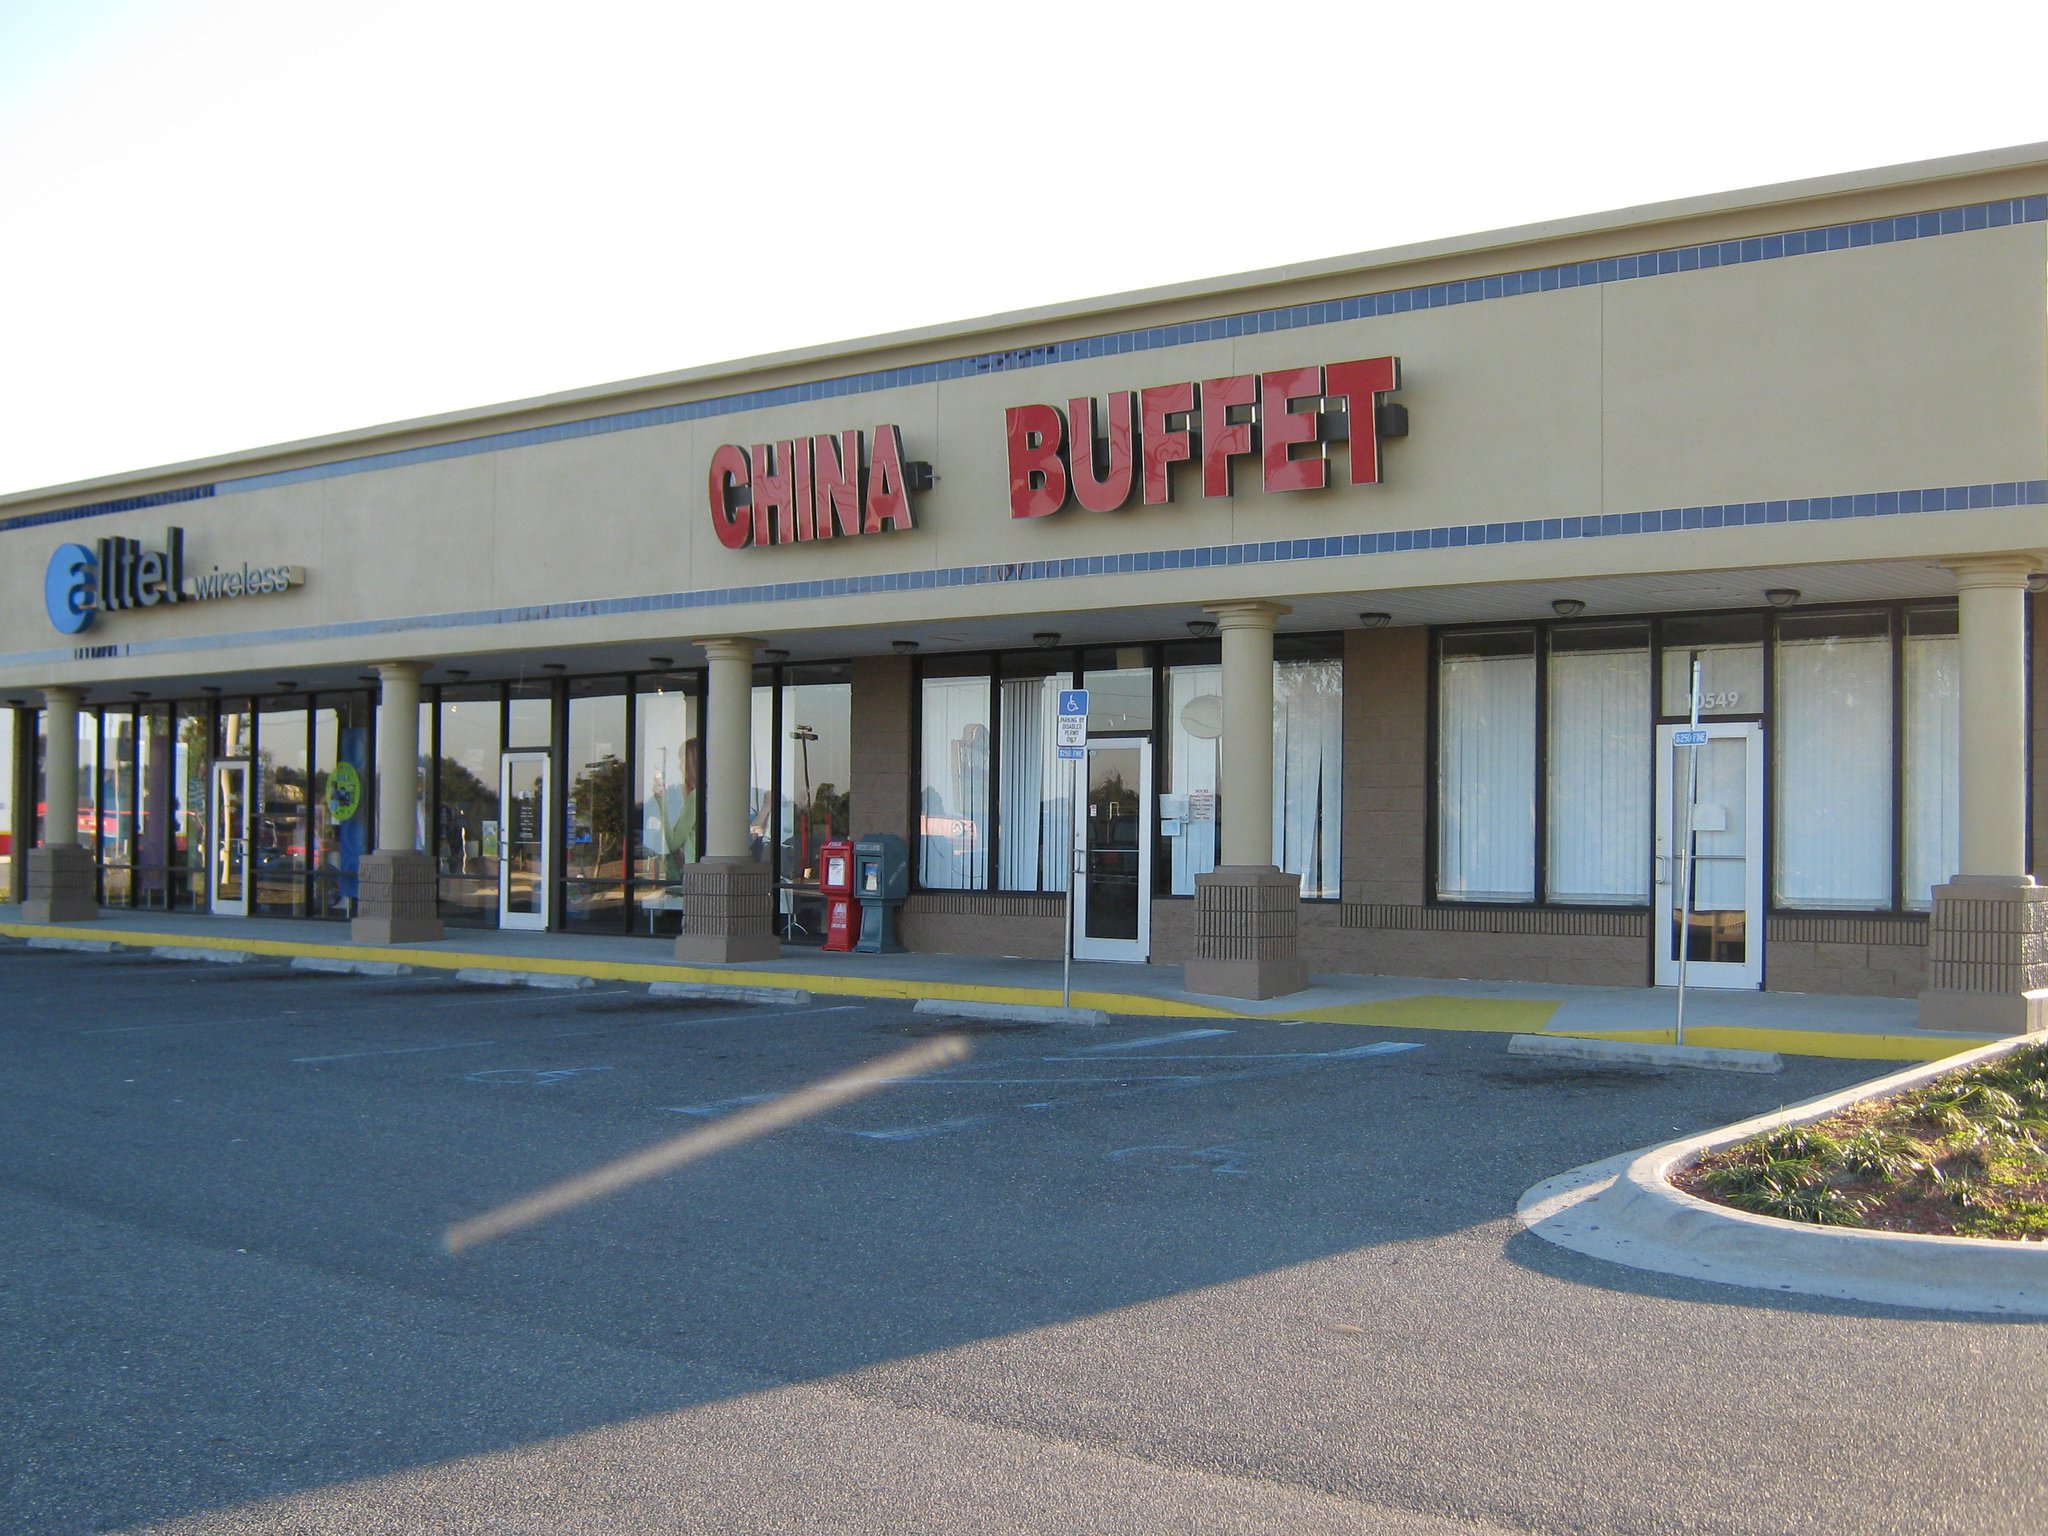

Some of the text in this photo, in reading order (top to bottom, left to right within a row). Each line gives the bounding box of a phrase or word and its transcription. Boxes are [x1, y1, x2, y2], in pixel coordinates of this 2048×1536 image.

[708, 356, 1402, 549] CHINA BUFFET
[67, 526, 291, 616] alltel wireless
[1675, 732, 1706, 743] $250 FINE
